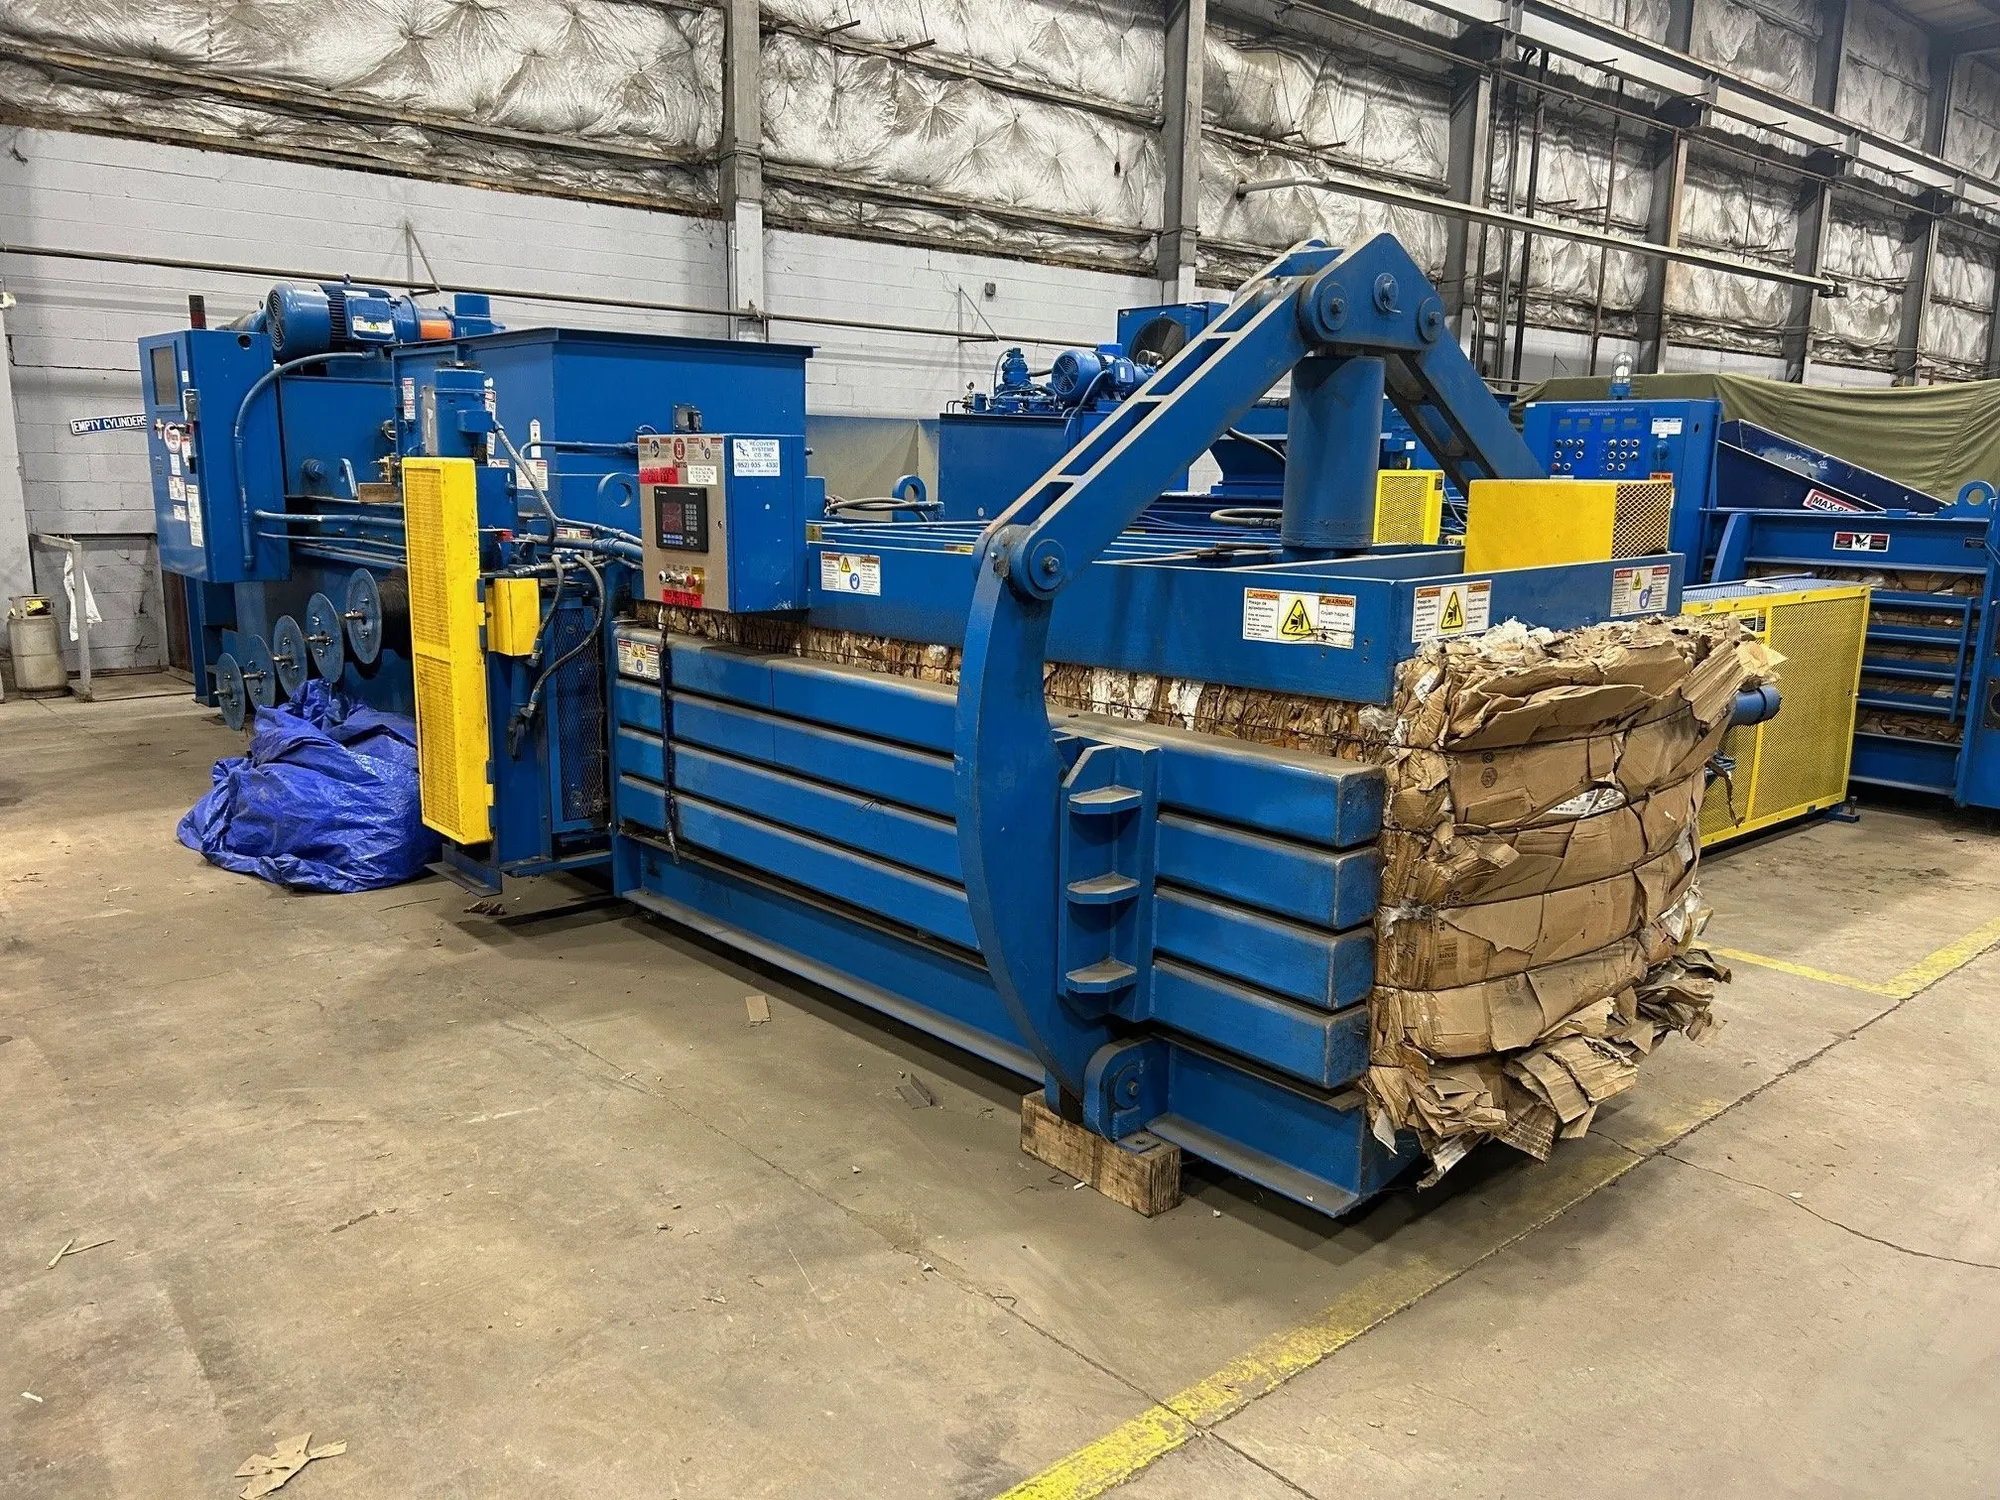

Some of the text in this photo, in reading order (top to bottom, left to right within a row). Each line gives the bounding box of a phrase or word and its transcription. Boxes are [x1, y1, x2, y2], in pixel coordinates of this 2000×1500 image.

[73, 416, 147, 432] EMPTY CYLINDERS
[1325, 598, 1353, 606] WARNING
